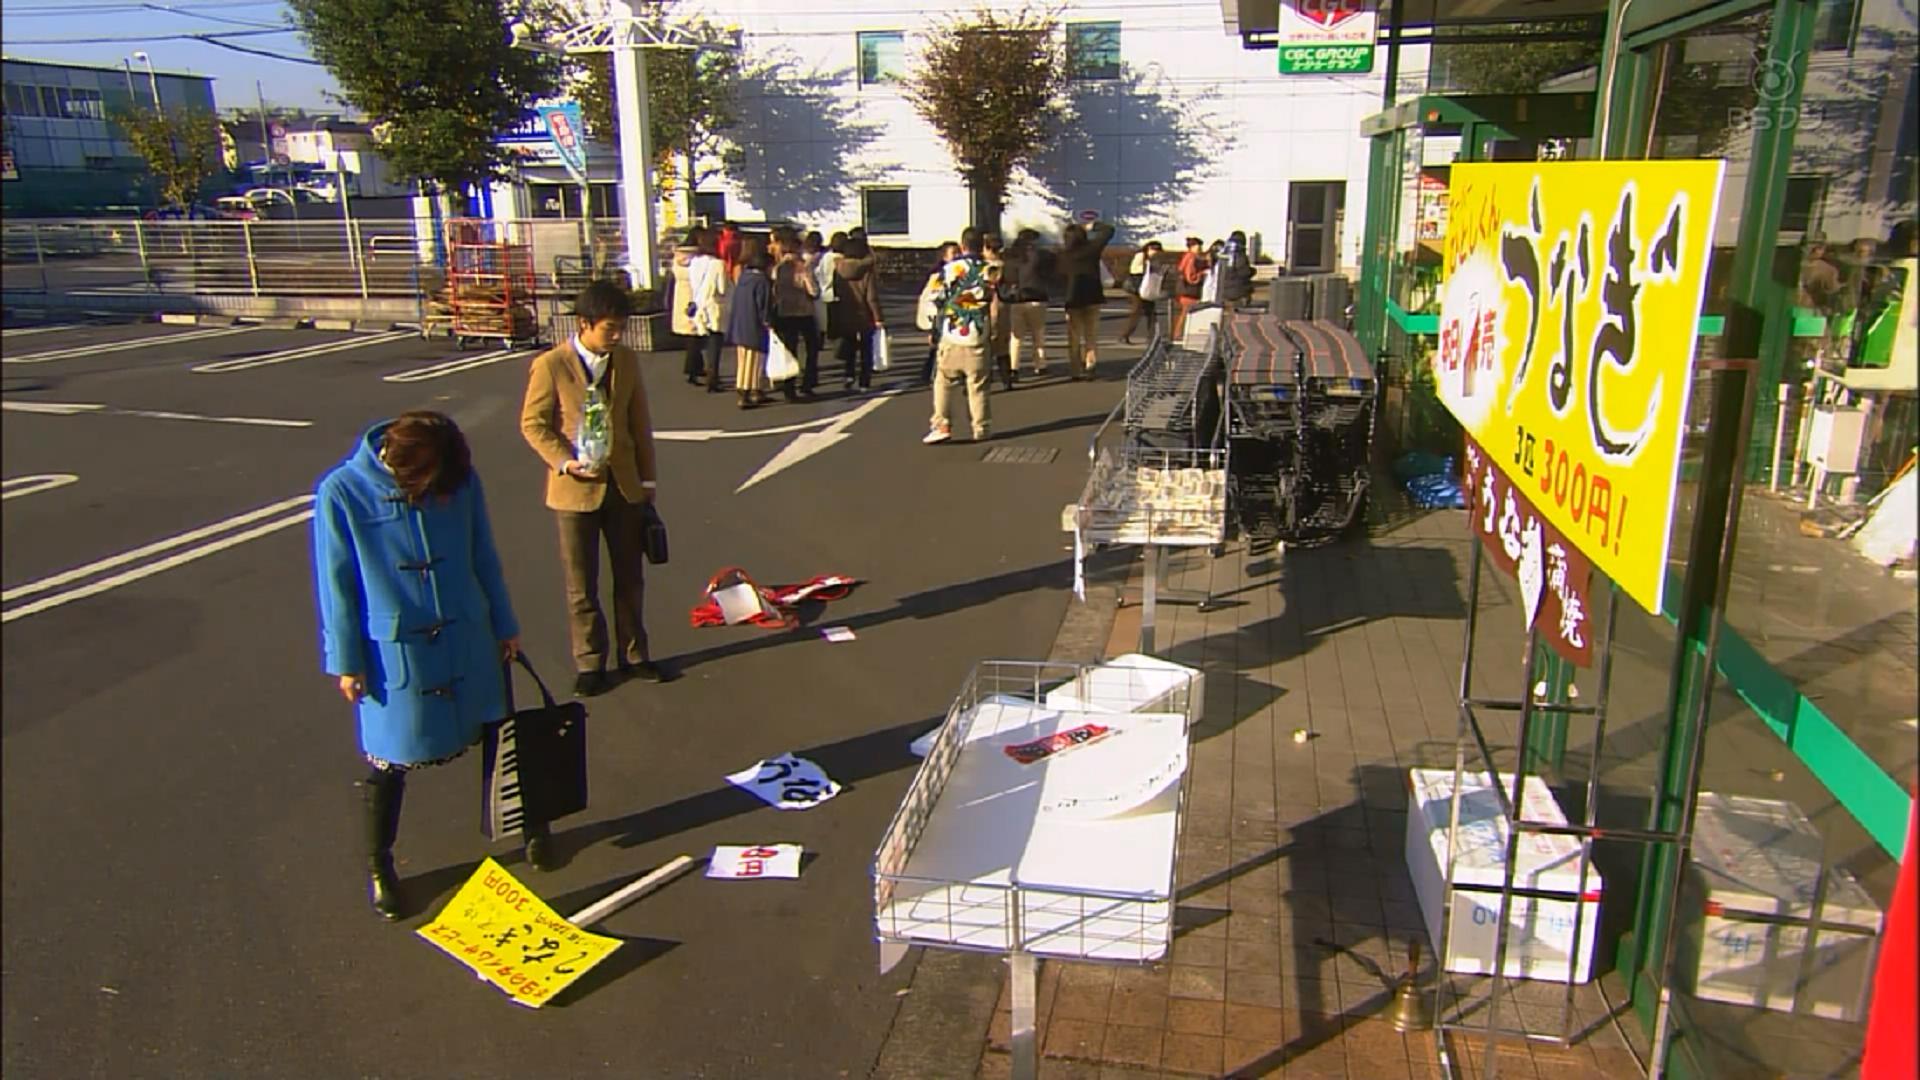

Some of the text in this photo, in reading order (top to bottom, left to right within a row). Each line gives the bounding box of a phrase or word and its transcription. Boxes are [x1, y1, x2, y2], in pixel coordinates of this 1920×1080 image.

[1285, 47, 1369, 61] CGC GROUP
[1501, 183, 1681, 455] うなぎ
[483, 923, 588, 982] うなぎ
